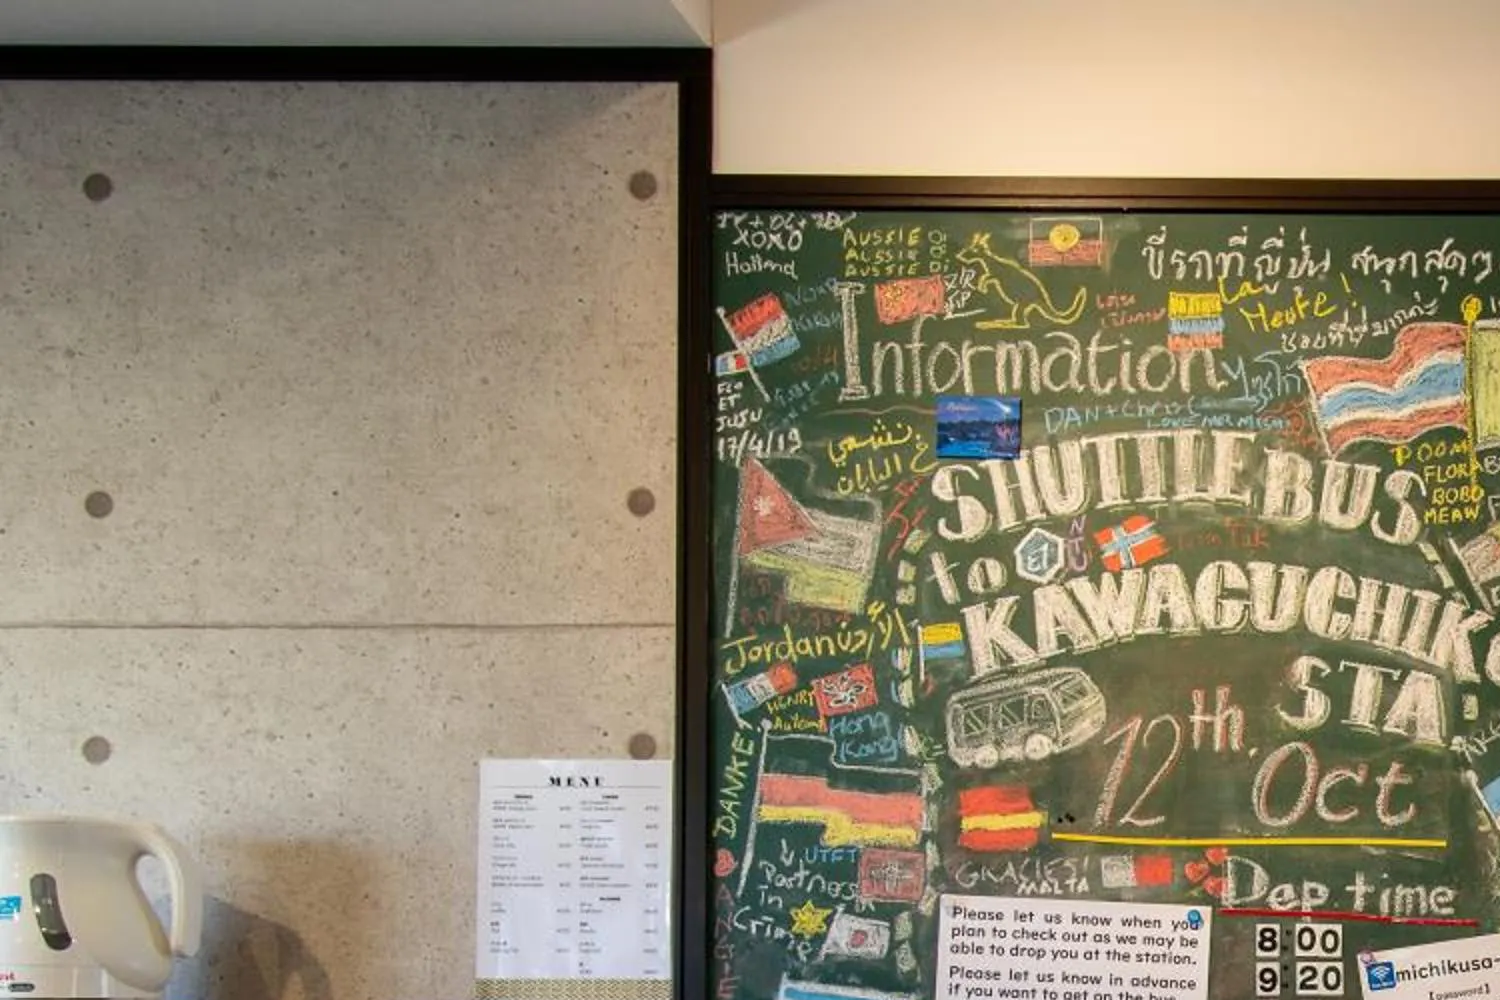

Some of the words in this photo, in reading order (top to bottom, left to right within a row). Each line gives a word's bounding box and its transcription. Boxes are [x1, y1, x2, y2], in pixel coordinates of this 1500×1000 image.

[835, 280, 1228, 401] Information
[928, 552, 1008, 604] to
[1251, 740, 1418, 828] Oct
[1346, 870, 1457, 916] time
[952, 905, 1004, 921] Please
[1013, 907, 1035, 923] let
[1044, 911, 1062, 925] us
[1071, 909, 1113, 927] know
[1121, 911, 1162, 929] when
[1171, 917, 1199, 934] you
[951, 925, 987, 941] plan
[991, 926, 1008, 940] to
[1011, 926, 1057, 941] check
[1061, 930, 1089, 943] out
[1093, 932, 1111, 944] as
[1115, 933, 1138, 945] we
[1142, 934, 1175, 951] may
[1179, 934, 1199, 948] be
[1258, 925, 1341, 953] 8:00
[950, 942, 985, 956] able
[988, 943, 1005, 956] to
[1009, 943, 1046, 962] drop
[1051, 949, 1080, 962] you
[1083, 948, 1101, 960] at
[1105, 949, 1131, 963] the
[1135, 950, 1197, 966] station.
[949, 965, 1002, 981] Please
[1009, 967, 1030, 982] let
[1036, 971, 1055, 983] us
[1061, 968, 1103, 985] know
[1109, 971, 1123, 986] in
[1131, 974, 1197, 991] advance
[949, 983, 961, 996] if
[965, 985, 993, 1000] you
[998, 985, 1037, 1000] want
[1042, 986, 1059, 1000] to
[1258, 963, 1342, 992] 9:20
